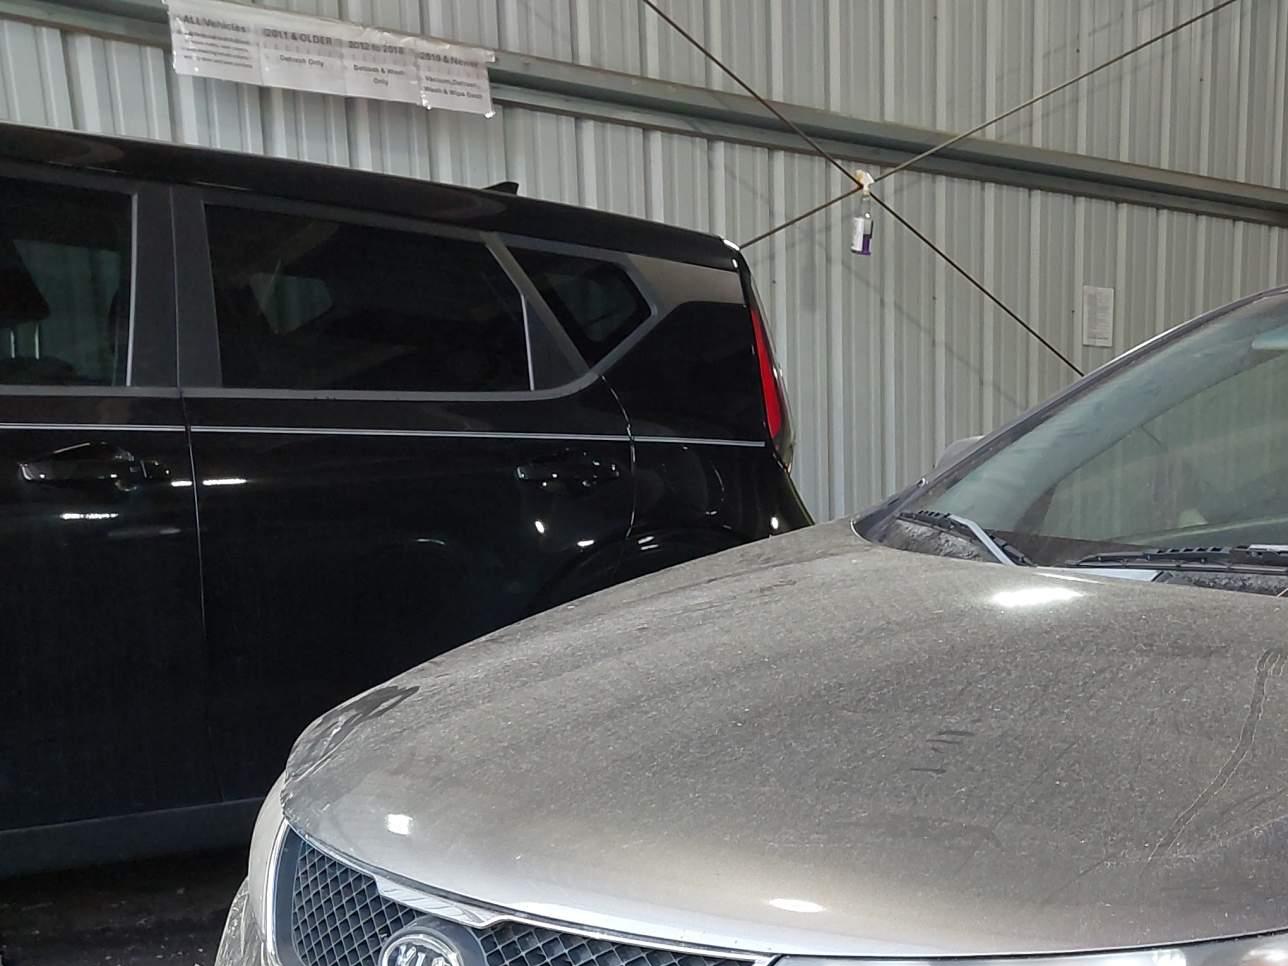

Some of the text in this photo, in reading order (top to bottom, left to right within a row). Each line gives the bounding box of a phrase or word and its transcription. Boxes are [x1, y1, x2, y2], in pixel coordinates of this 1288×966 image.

[183, 15, 247, 32] ALL Vehicles
[299, 33, 333, 45] OLDER
